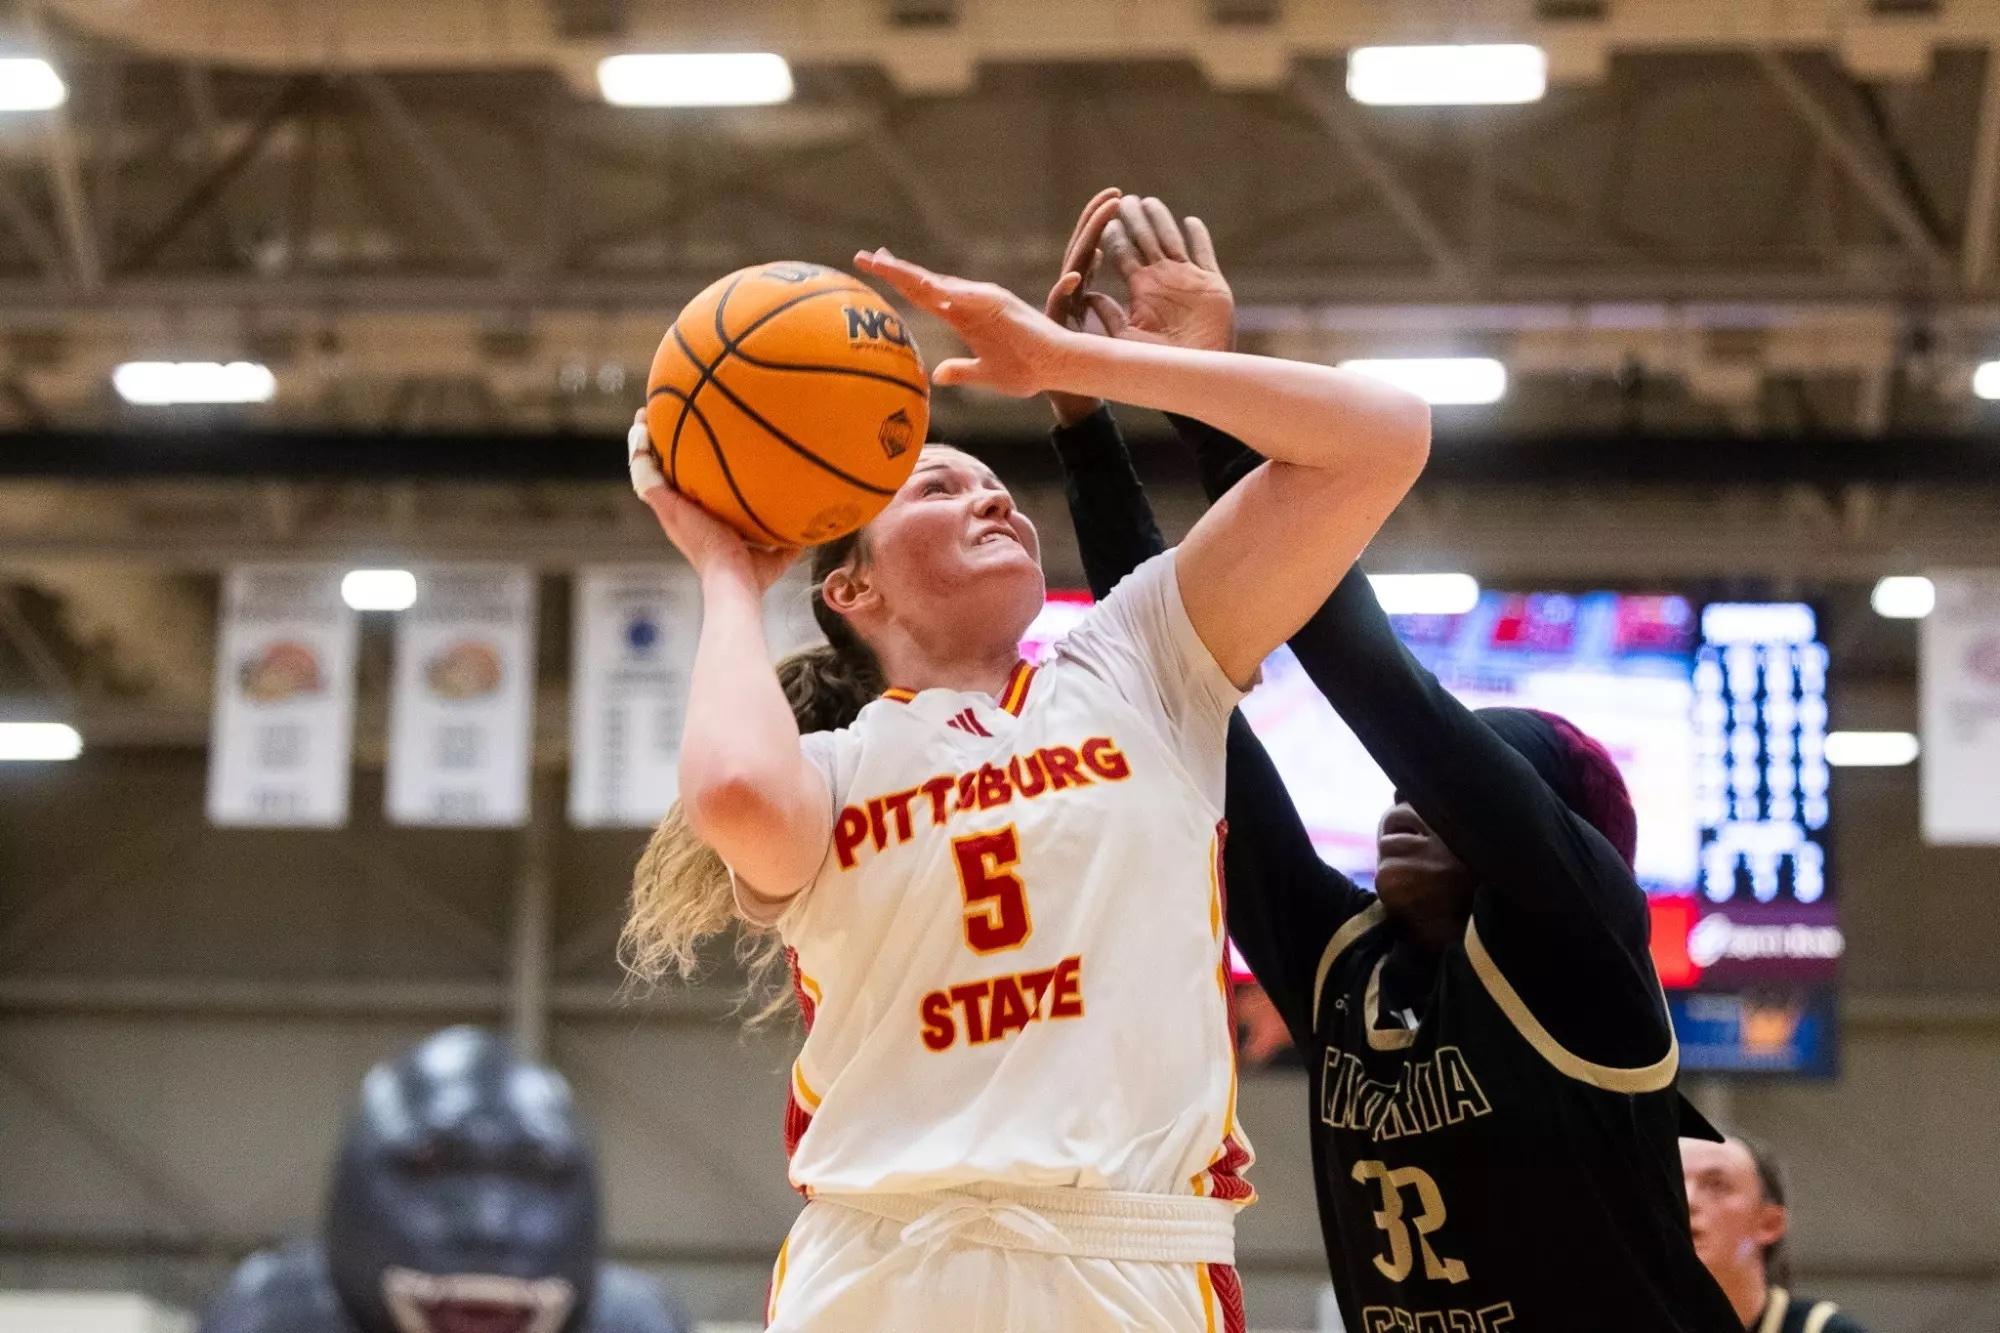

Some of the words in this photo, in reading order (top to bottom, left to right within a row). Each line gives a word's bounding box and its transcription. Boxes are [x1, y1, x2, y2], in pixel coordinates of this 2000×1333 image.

[833, 736, 1133, 872] PITTSBURG
[950, 821, 1033, 957] 5
[920, 953, 1085, 1053] STATE
[1351, 1159, 1470, 1285] 32
